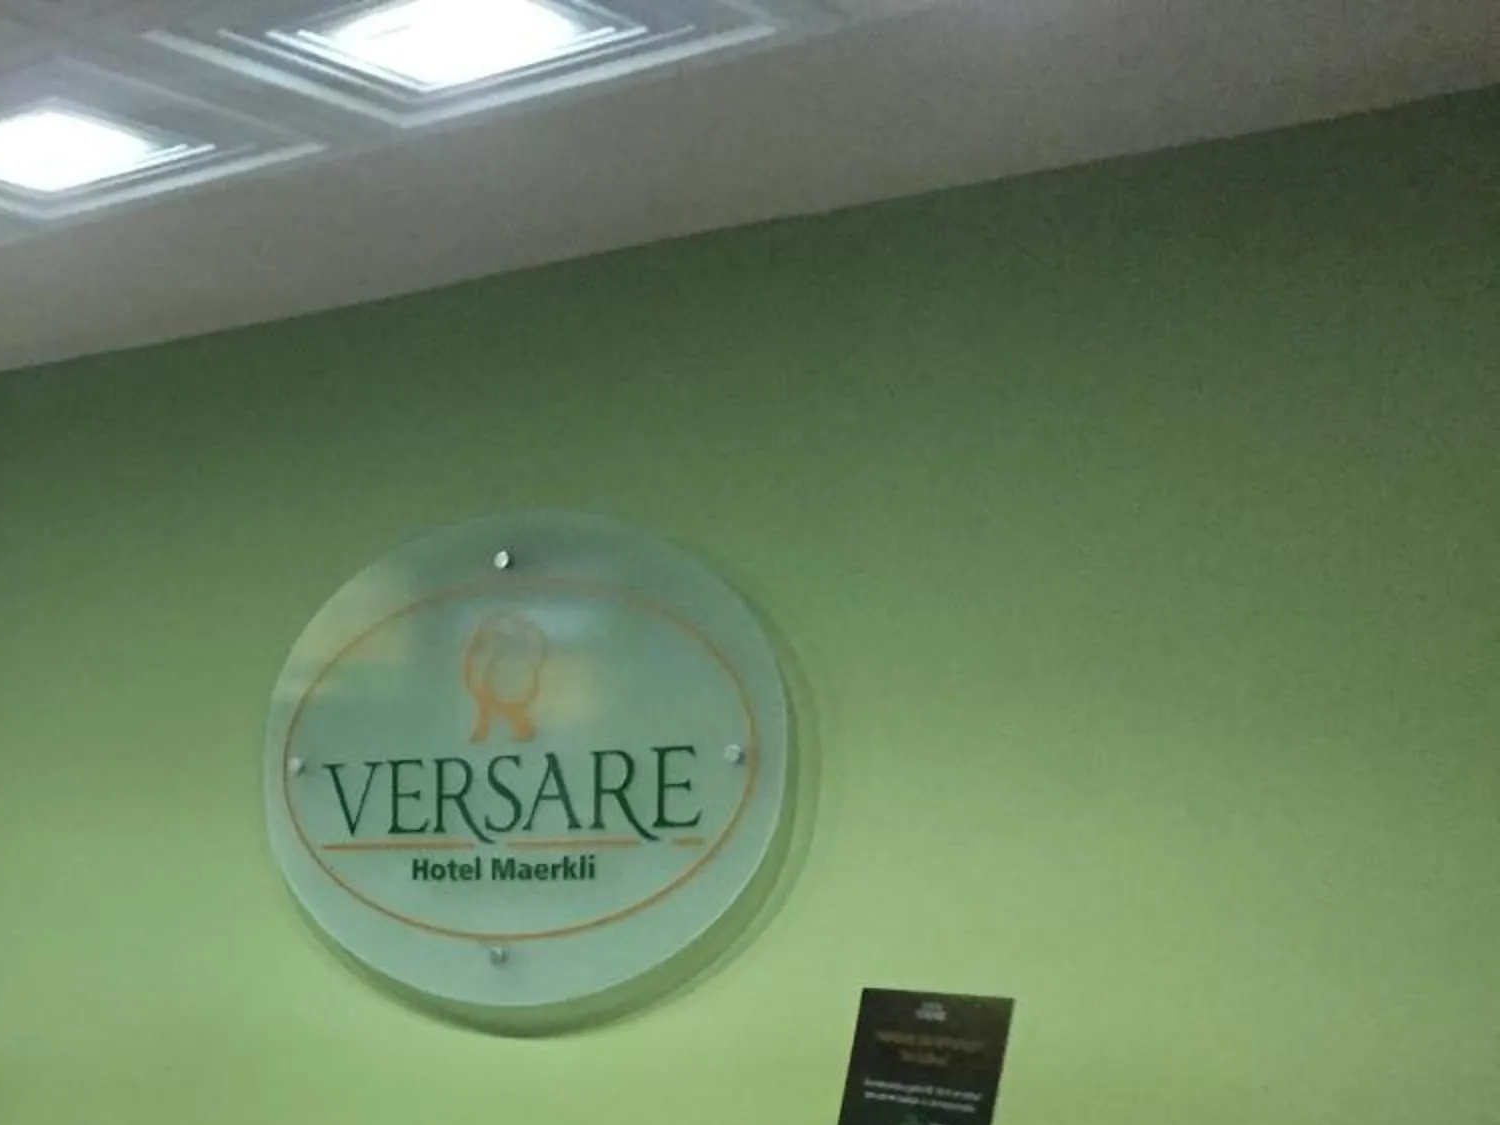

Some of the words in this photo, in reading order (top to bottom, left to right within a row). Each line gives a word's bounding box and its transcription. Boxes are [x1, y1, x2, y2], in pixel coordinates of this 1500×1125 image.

[323, 745, 702, 845] VERSARE
[411, 857, 481, 882] Hotel
[491, 855, 596, 882] Maerkli
